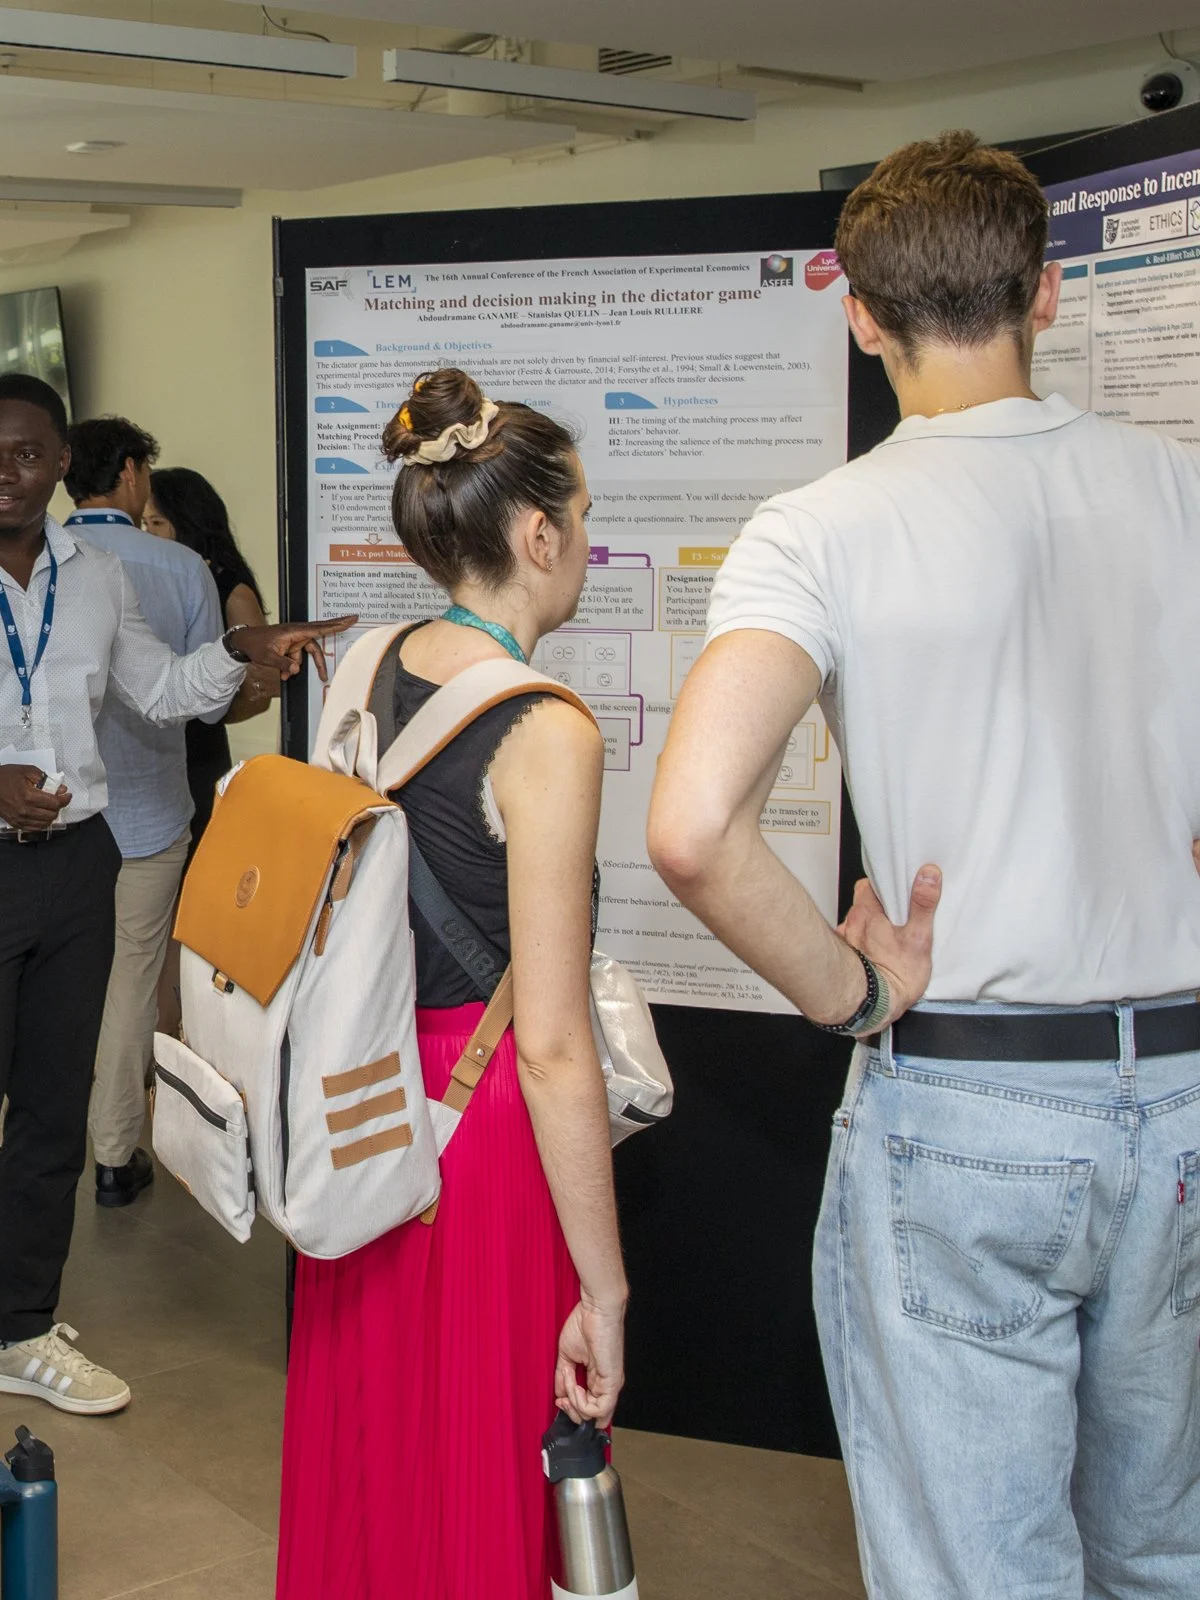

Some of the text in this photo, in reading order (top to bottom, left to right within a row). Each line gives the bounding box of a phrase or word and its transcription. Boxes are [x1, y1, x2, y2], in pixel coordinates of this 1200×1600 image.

[1052, 192, 1076, 216] and
[1078, 182, 1141, 211] Response
[1144, 177, 1158, 196] to
[1150, 210, 1182, 231] ETHICS
[649, 265, 703, 274] Experimental
[310, 280, 347, 292] SAF
[373, 275, 412, 288] LEM
[762, 278, 792, 288] ASFEE
[364, 288, 762, 310] Matching and decision making in the dictator game
[564, 310, 599, 318] QUELIN
[376, 343, 429, 352] Background
[444, 341, 492, 351] Objectives
[527, 356, 548, 365] solely
[315, 372, 360, 380] experimental
[362, 371, 400, 379] procedures
[618, 365, 650, 374] Forsythe
[333, 382, 351, 390] study
[664, 396, 718, 406] Hypotheses
[642, 417, 666, 425] timing
[678, 416, 690, 424] the
[692, 416, 727, 424] matching
[602, 493, 623, 502] begin
[591, 515, 625, 523] complete
[331, 525, 377, 534] questionnaire
[590, 585, 632, 593] designation
[322, 590, 359, 598] Participant
[666, 596, 706, 604] Participant
[666, 607, 706, 616] Participant
[646, 704, 670, 714] during
[630, 898, 668, 906] behavioral
[669, 931, 693, 940] design
